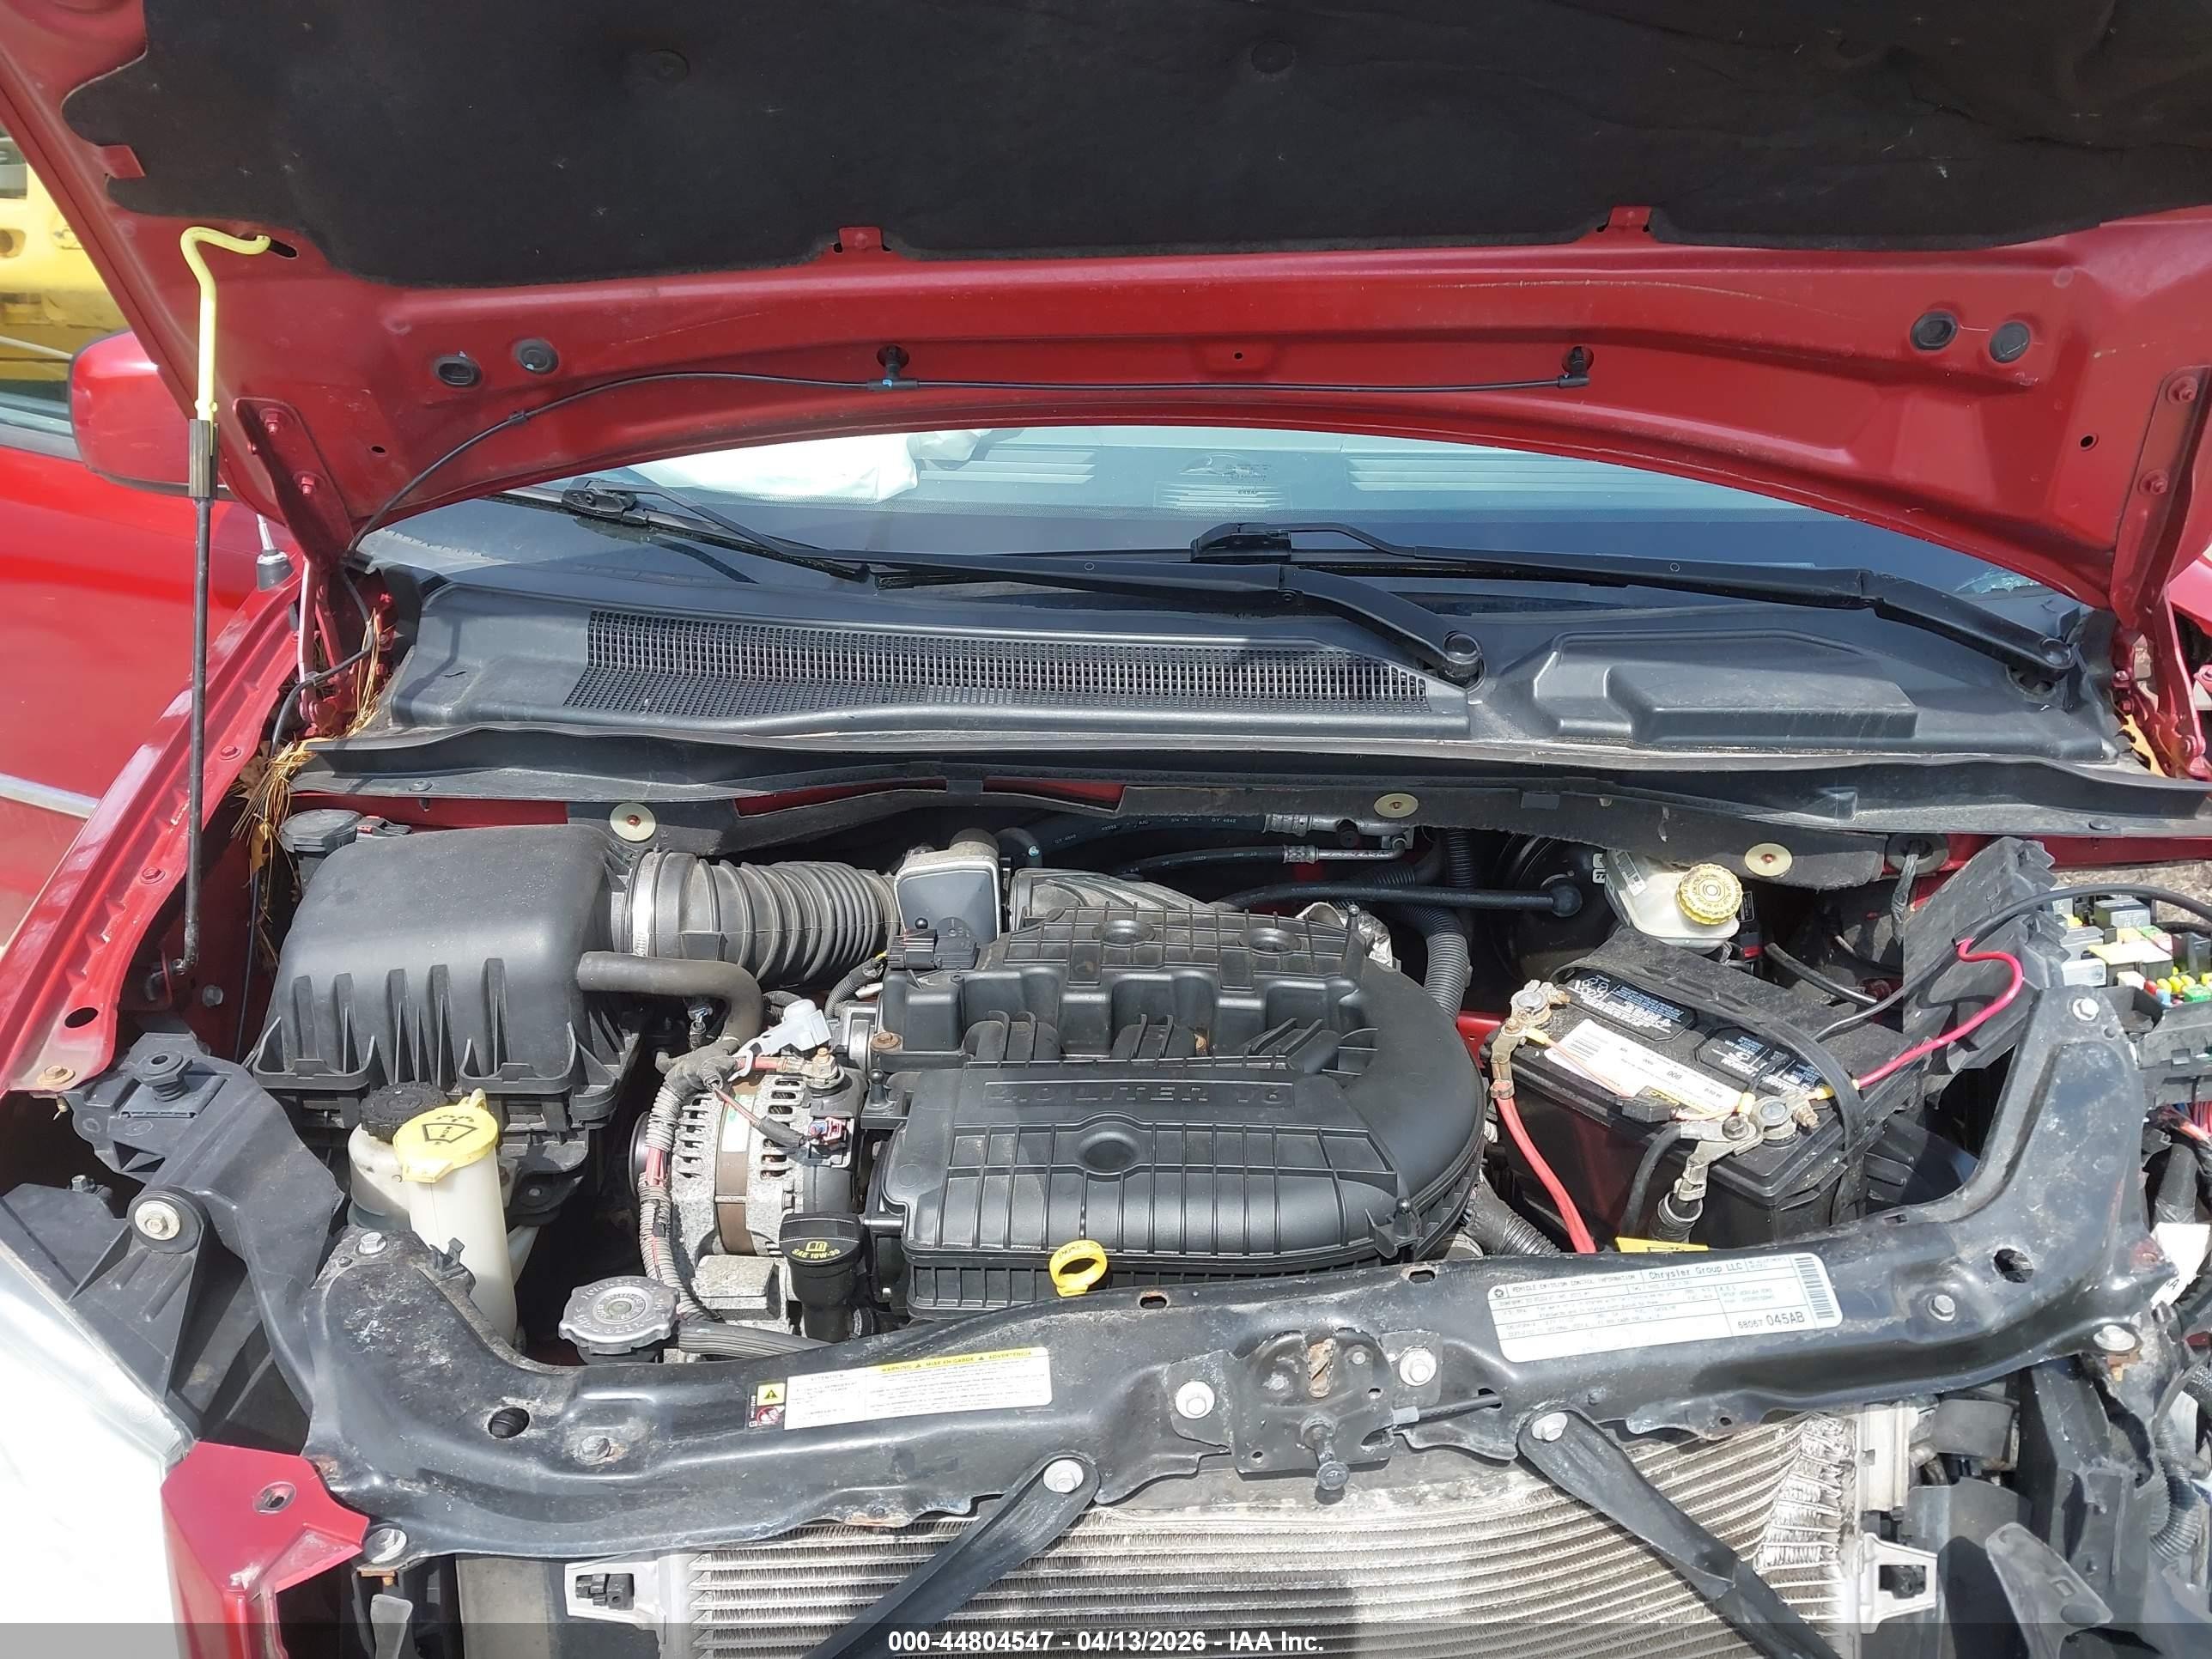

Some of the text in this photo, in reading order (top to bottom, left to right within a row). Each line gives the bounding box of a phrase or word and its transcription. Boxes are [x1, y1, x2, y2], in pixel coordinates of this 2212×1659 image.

[1076, 1085, 1209, 1103] LITER
[791, 1248, 842, 1261] SAE 10W-30
[1648, 1267, 1691, 1281] Chrysler
[1694, 1265, 1723, 1278] Group
[1724, 1261, 1744, 1273] LLC
[1570, 1278, 1595, 1287] CONTROL
[1597, 1273, 1637, 1284] INFORMATION
[1765, 1310, 1806, 1327] 045AB
